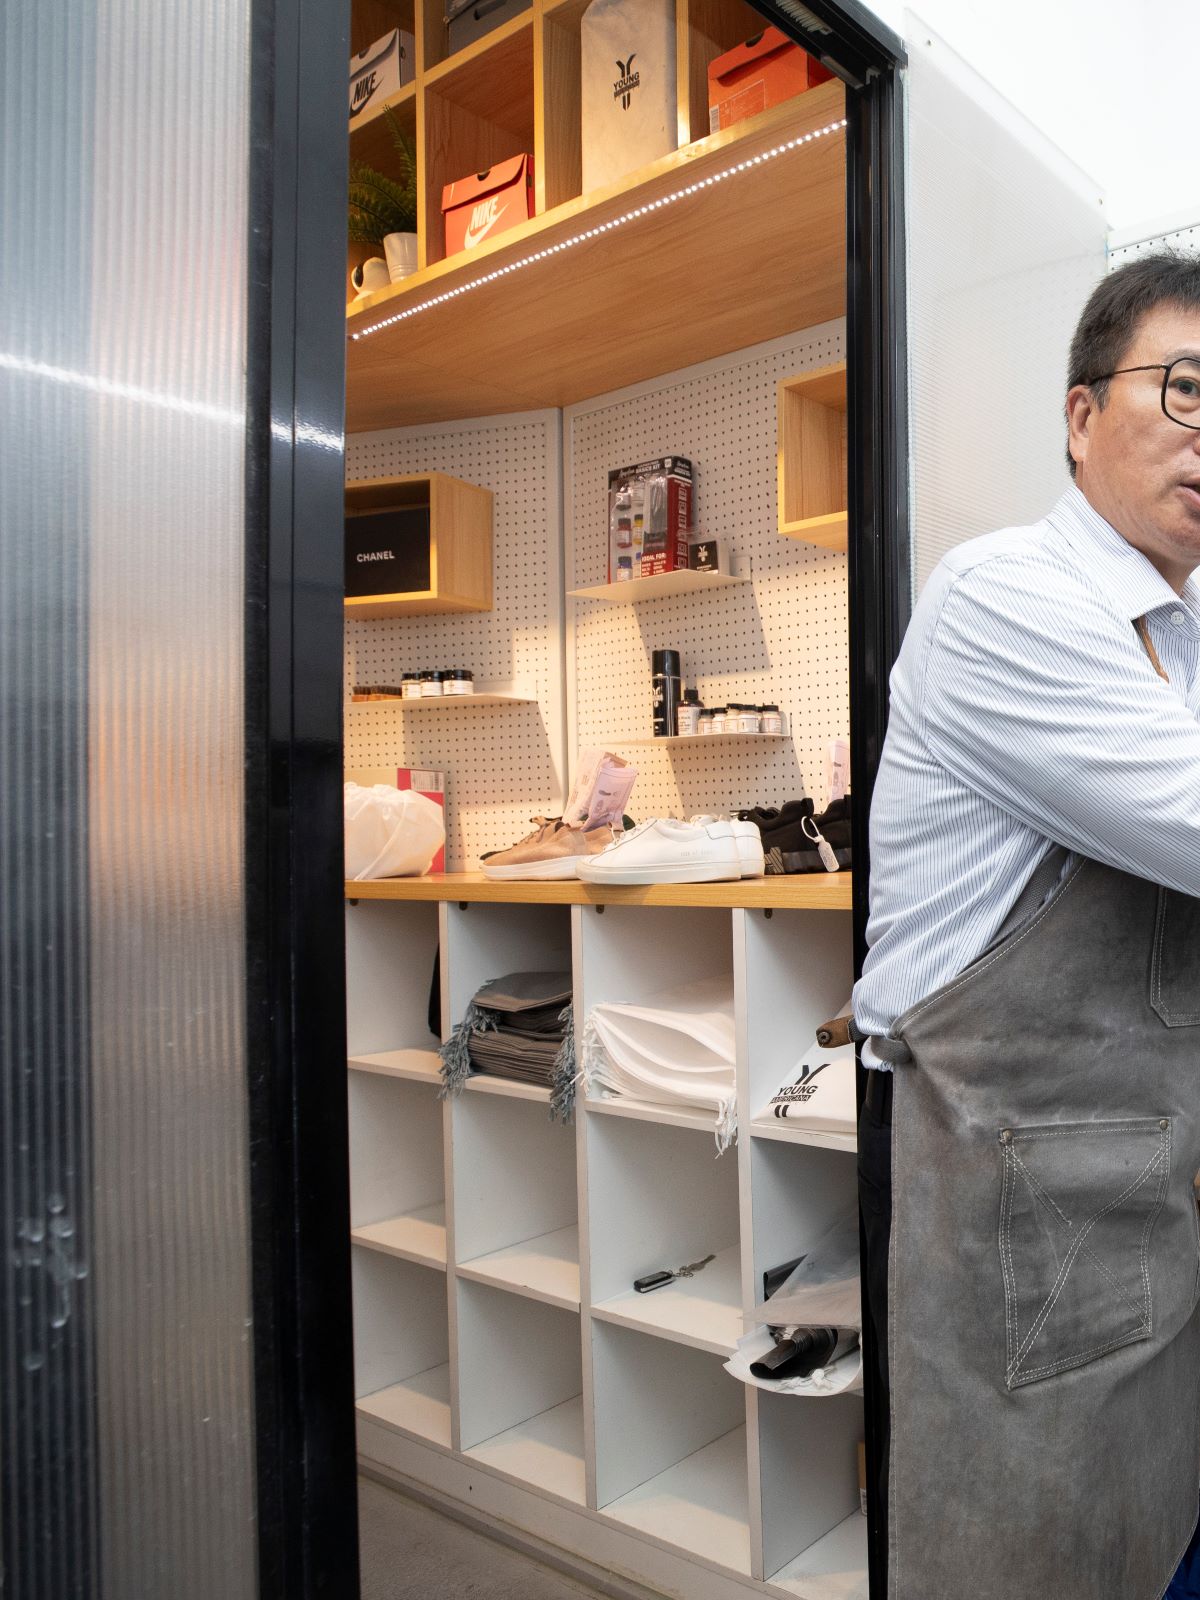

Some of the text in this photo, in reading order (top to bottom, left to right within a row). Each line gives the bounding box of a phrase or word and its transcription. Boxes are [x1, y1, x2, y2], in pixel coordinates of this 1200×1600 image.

[353, 71, 377, 105] NIKE
[613, 71, 640, 90] YOUNG
[470, 195, 499, 232] NIKE
[356, 550, 395, 563] CHANEL
[777, 1085, 818, 1096] YOUNG
